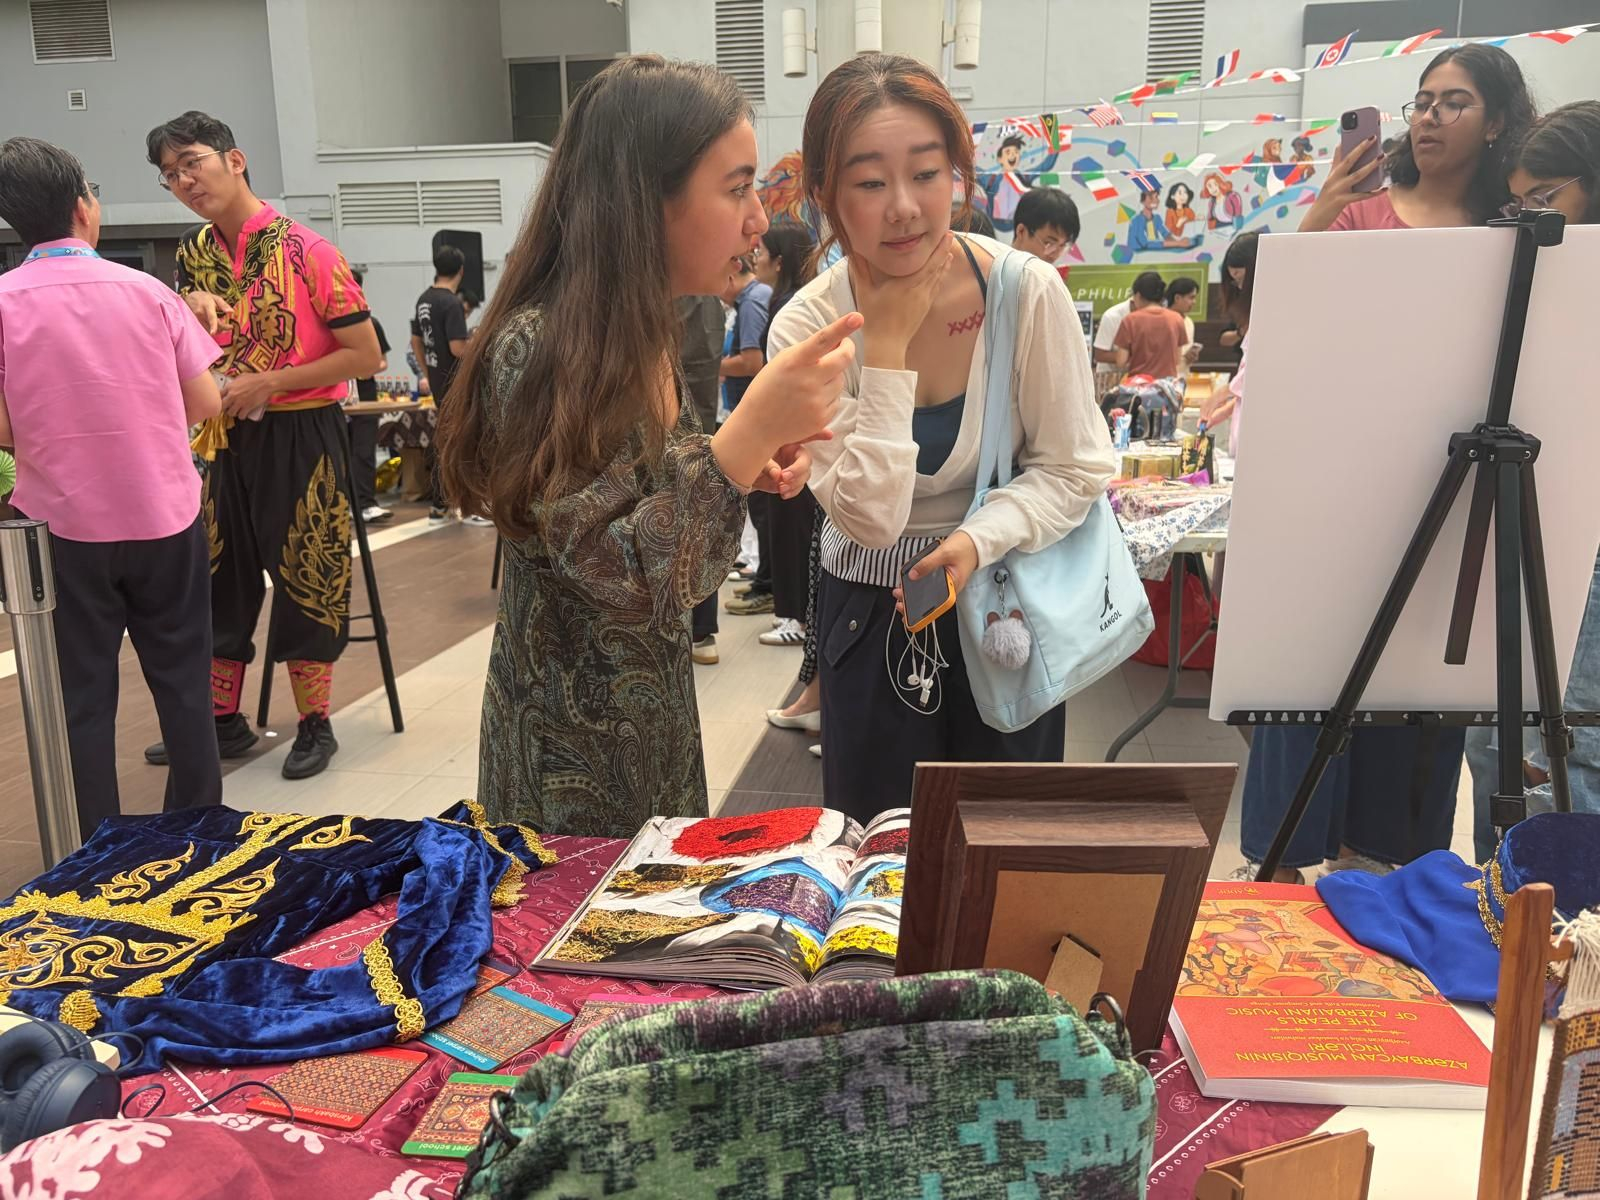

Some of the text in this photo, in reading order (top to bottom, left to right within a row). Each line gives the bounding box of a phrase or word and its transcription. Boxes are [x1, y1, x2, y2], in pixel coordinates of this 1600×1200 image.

[250, 279, 296, 352] 南
[1099, 610, 1123, 632] KANGOL
[1225, 1007, 1418, 1020] OF AZERBAIJANI MUSIC
[1277, 1016, 1382, 1027] THE PEARLS
[1308, 1042, 1387, 1054] İNCİLƏRİ
[1235, 1051, 1468, 1070] AZƏRBAYCAN MUSİQİSİNİN
[452, 1144, 477, 1152] rpet
